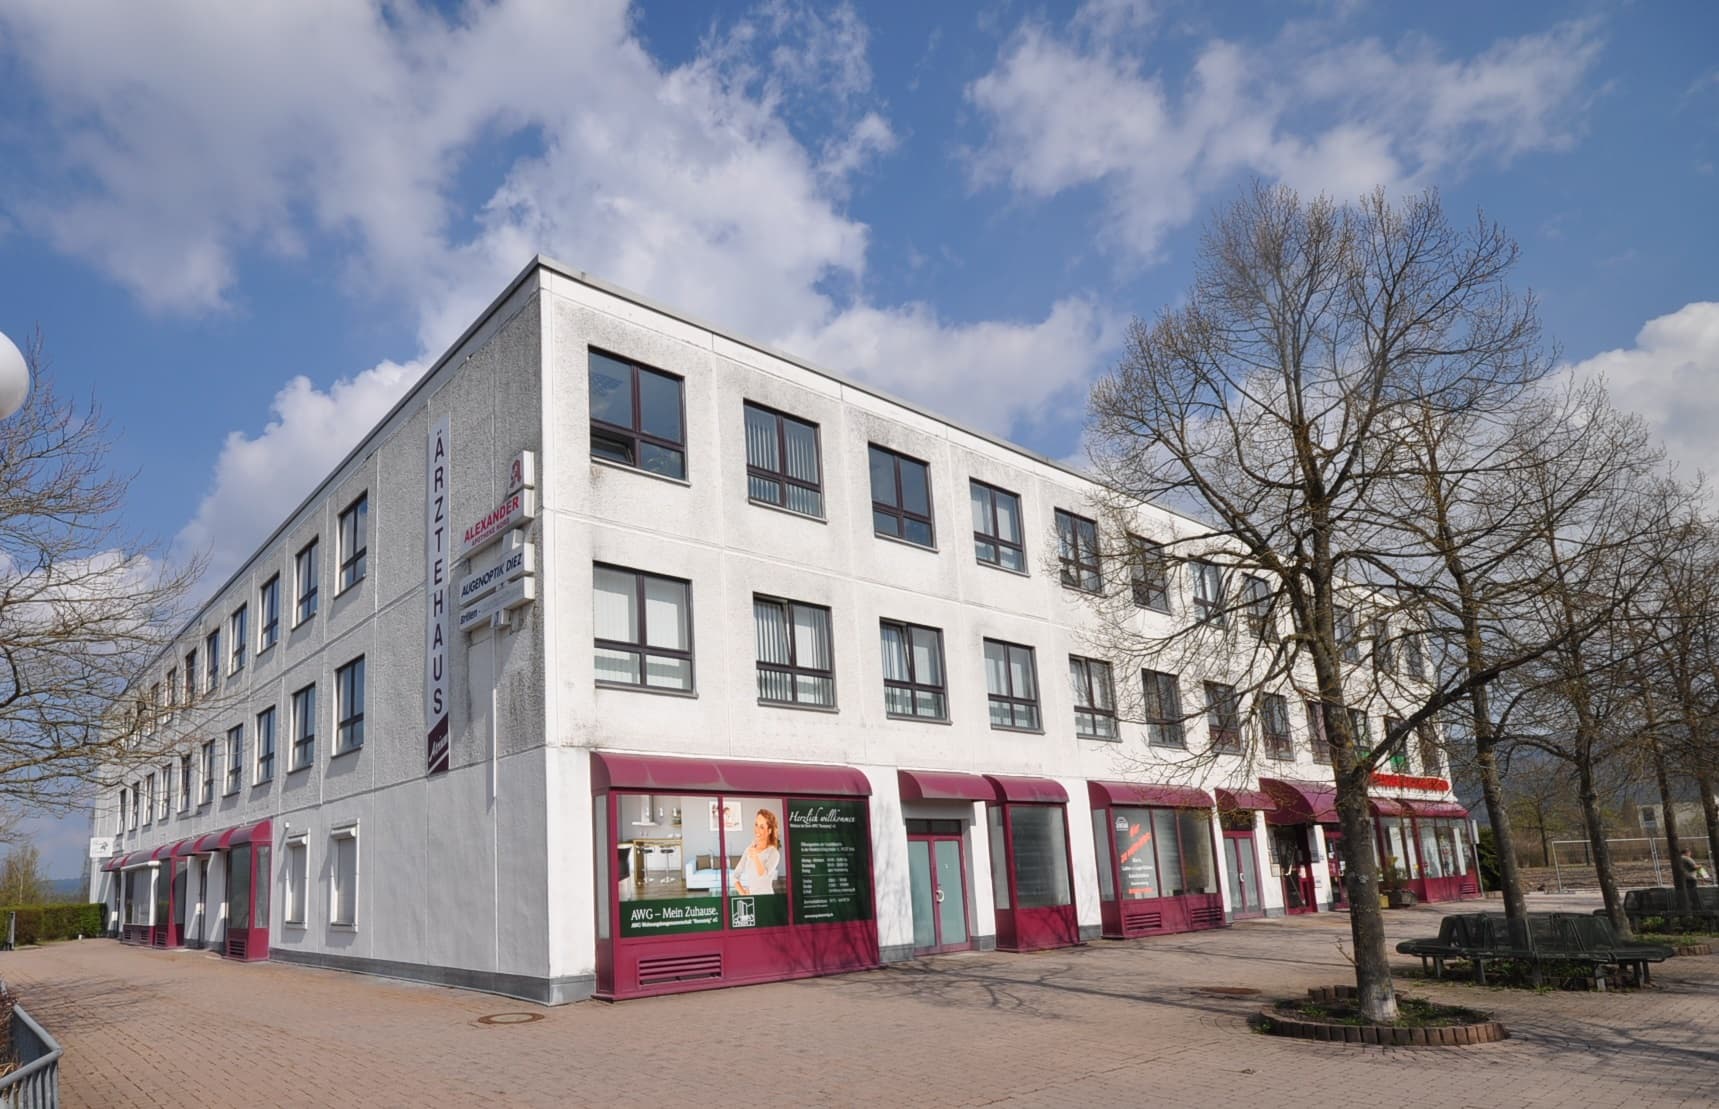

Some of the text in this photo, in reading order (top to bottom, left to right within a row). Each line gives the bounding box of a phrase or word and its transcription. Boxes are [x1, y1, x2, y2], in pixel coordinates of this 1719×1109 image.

[464, 495, 520, 544] ALEXANDER
[433, 429, 445, 715] ÄRZTEHAUS
[461, 552, 523, 598] AUGENOPTIK DIEZ
[789, 806, 824, 825] Herzlich
[631, 908, 654, 921] AWG
[662, 907, 684, 919] Mein
[684, 906, 719, 917] Zuhause.
